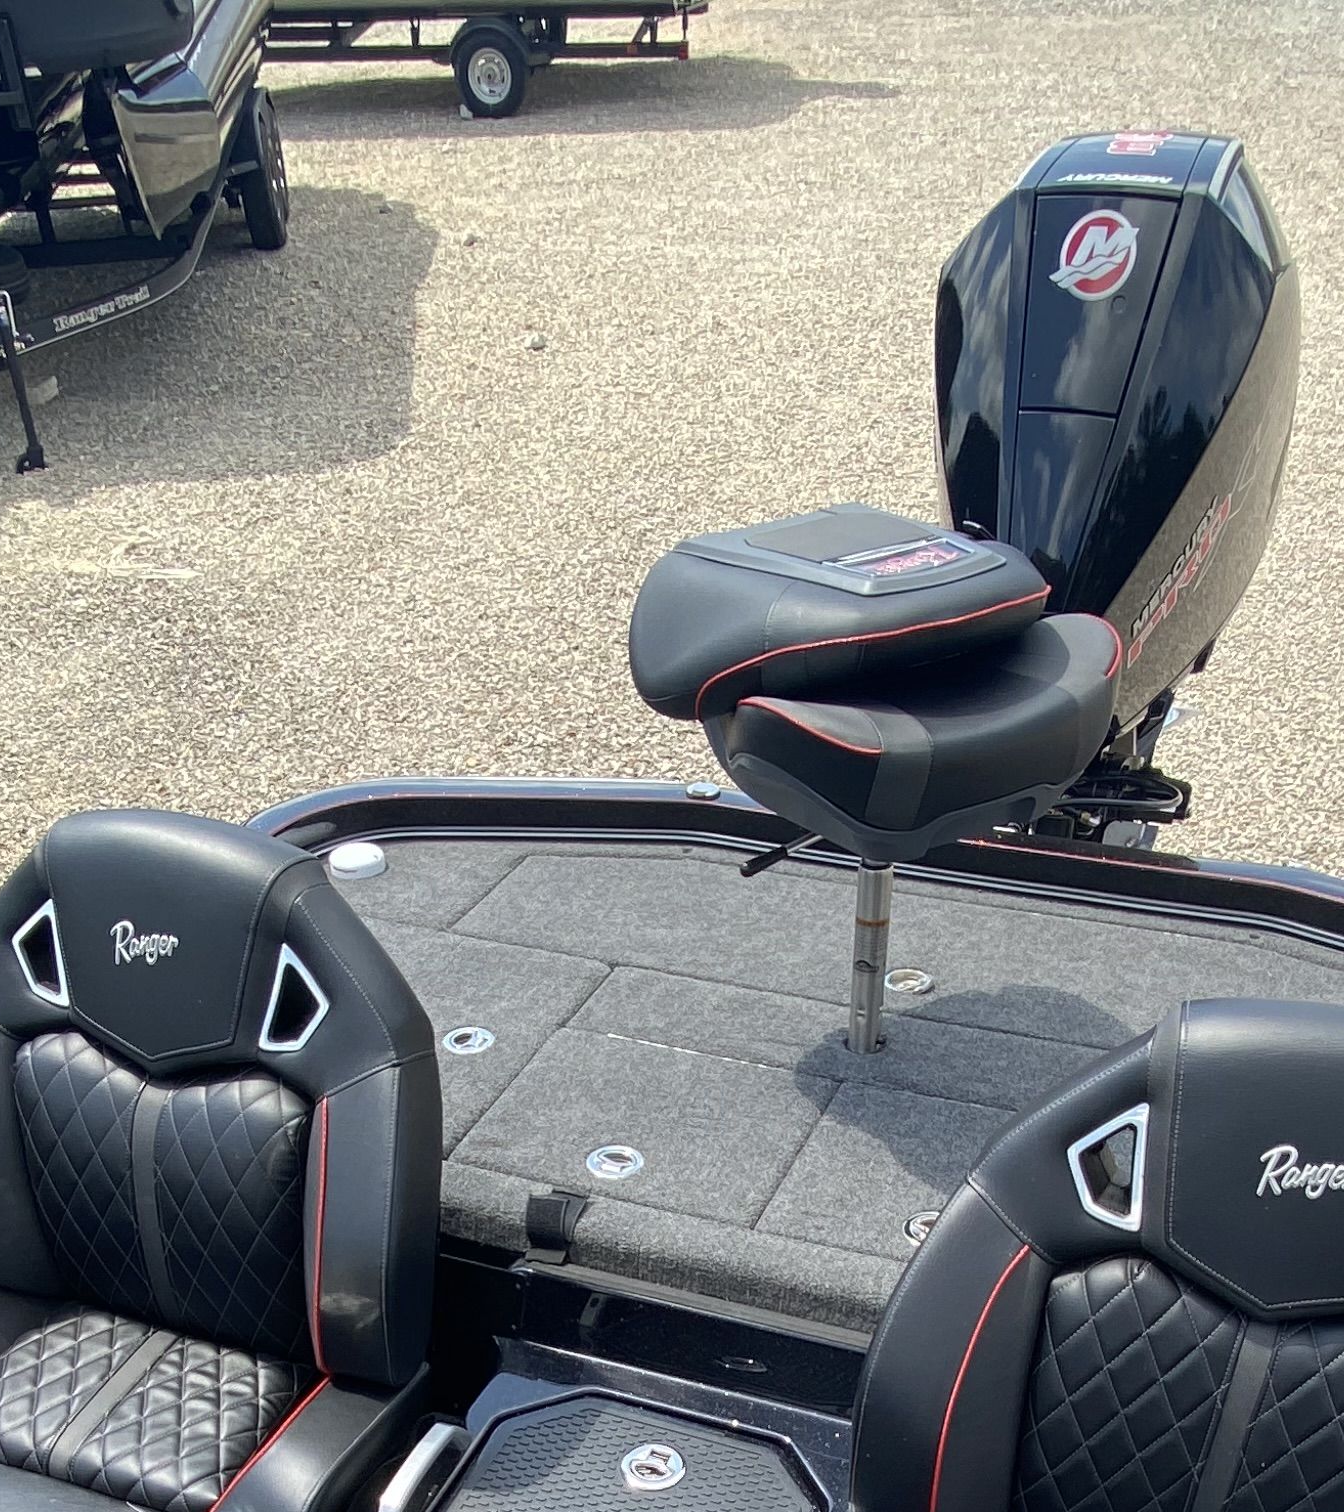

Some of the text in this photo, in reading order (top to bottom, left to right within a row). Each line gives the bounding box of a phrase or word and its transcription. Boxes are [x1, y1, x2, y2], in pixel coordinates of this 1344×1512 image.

[1057, 173, 1173, 184] MERCURY
[53, 301, 115, 332] Ranger
[1130, 494, 1218, 638] MERCURY
[110, 920, 179, 966] Ranger
